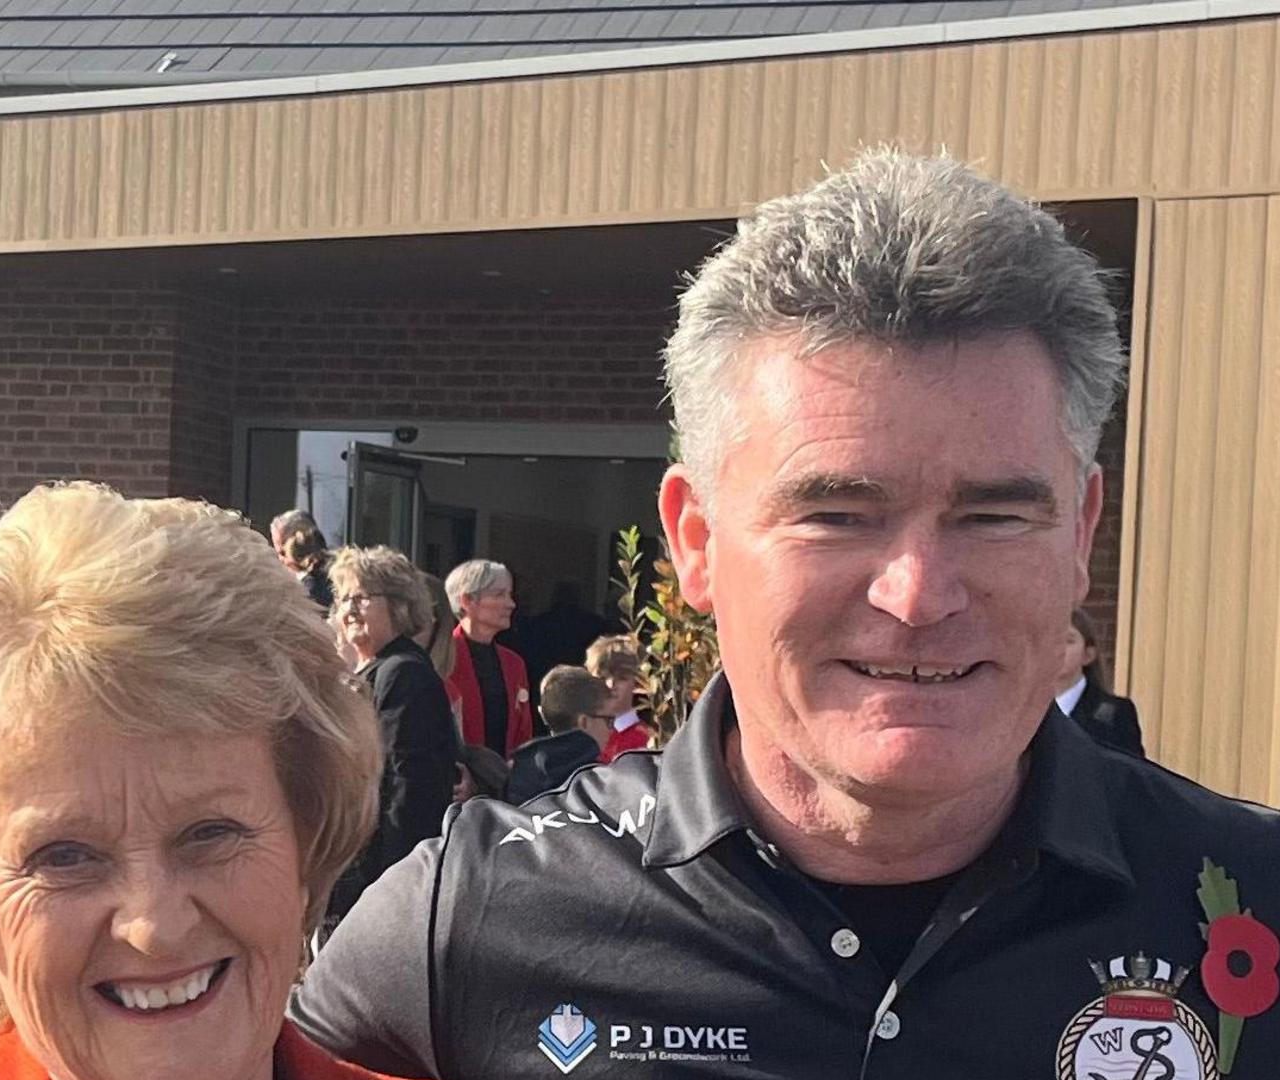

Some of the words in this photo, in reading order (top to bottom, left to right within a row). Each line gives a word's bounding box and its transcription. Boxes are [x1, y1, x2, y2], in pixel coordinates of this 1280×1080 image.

[609, 1024, 632, 1048] P
[640, 1025, 653, 1048] J
[663, 1025, 749, 1050] DYKE
[1089, 1026, 1124, 1055] W
